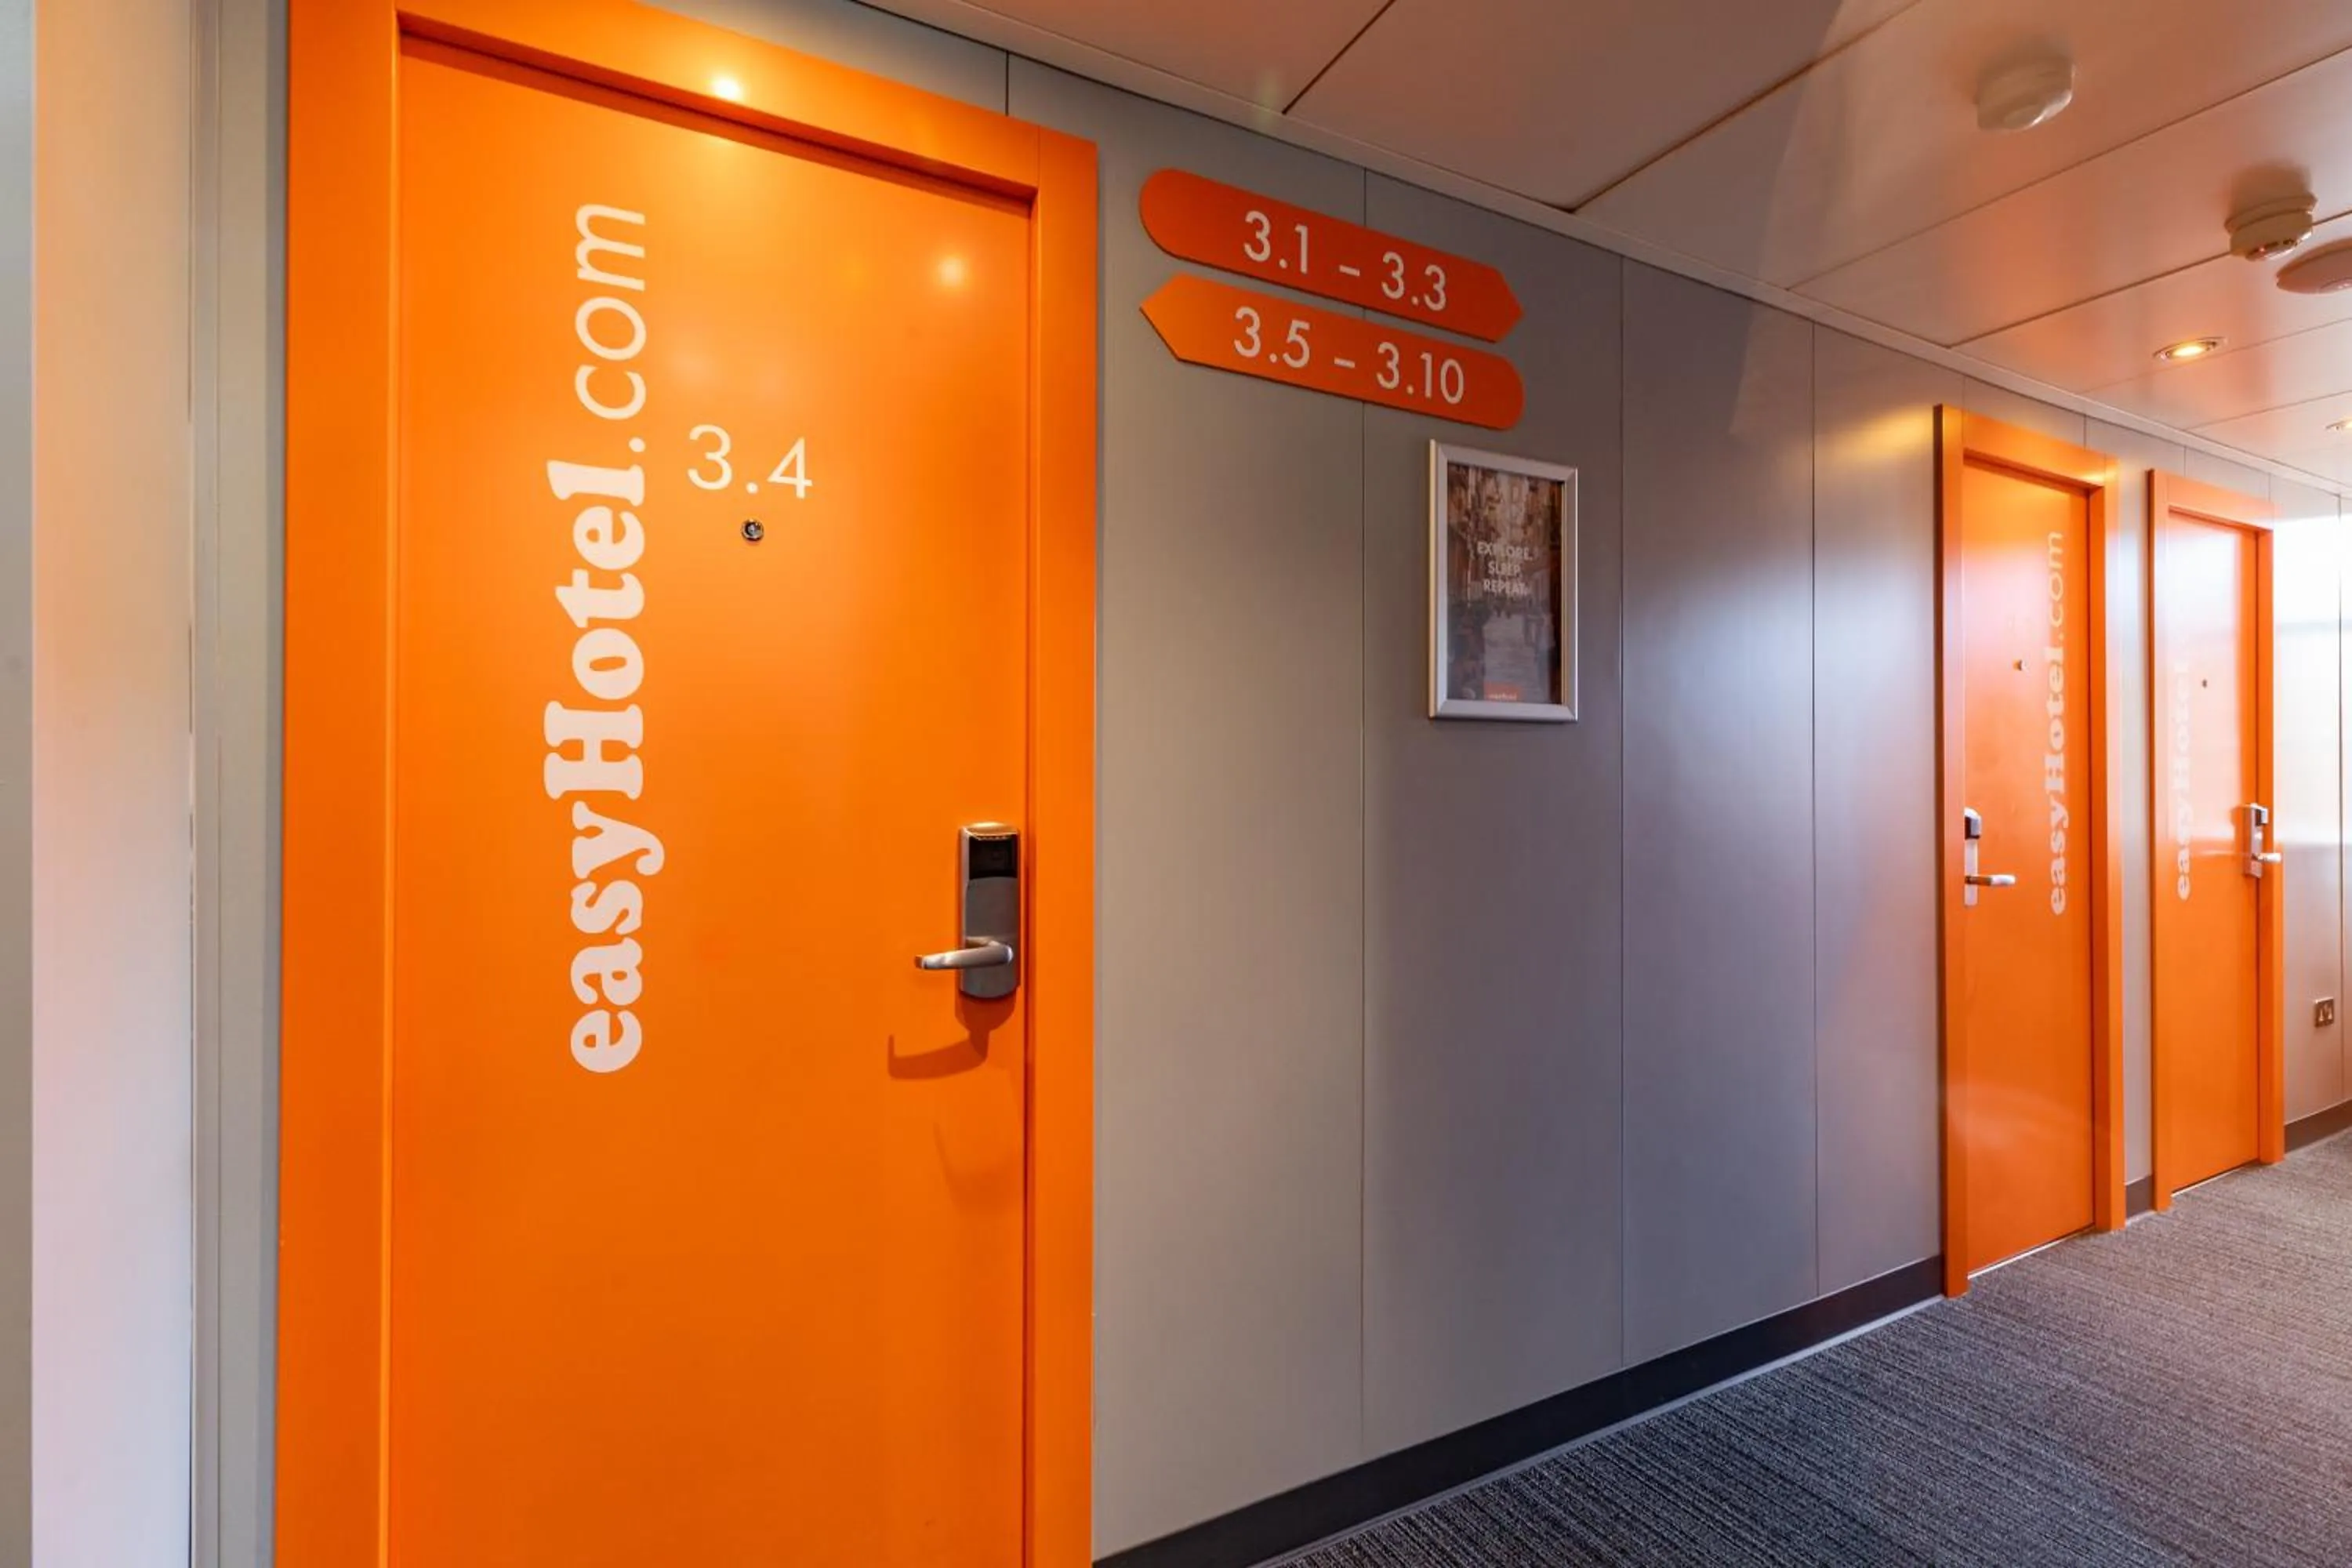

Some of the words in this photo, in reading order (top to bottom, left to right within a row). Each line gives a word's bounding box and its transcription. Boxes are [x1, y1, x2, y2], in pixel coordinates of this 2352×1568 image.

[1243, 210, 1308, 274] 3.1
[1381, 251, 1447, 311] 3.3
[1233, 307, 1311, 368] 3.5
[1376, 341, 1465, 405] 3.10
[687, 424, 813, 499] 3.4
[543, 203, 665, 1073] easyHotel.com
[2044, 531, 2069, 915] easyHotel.com
